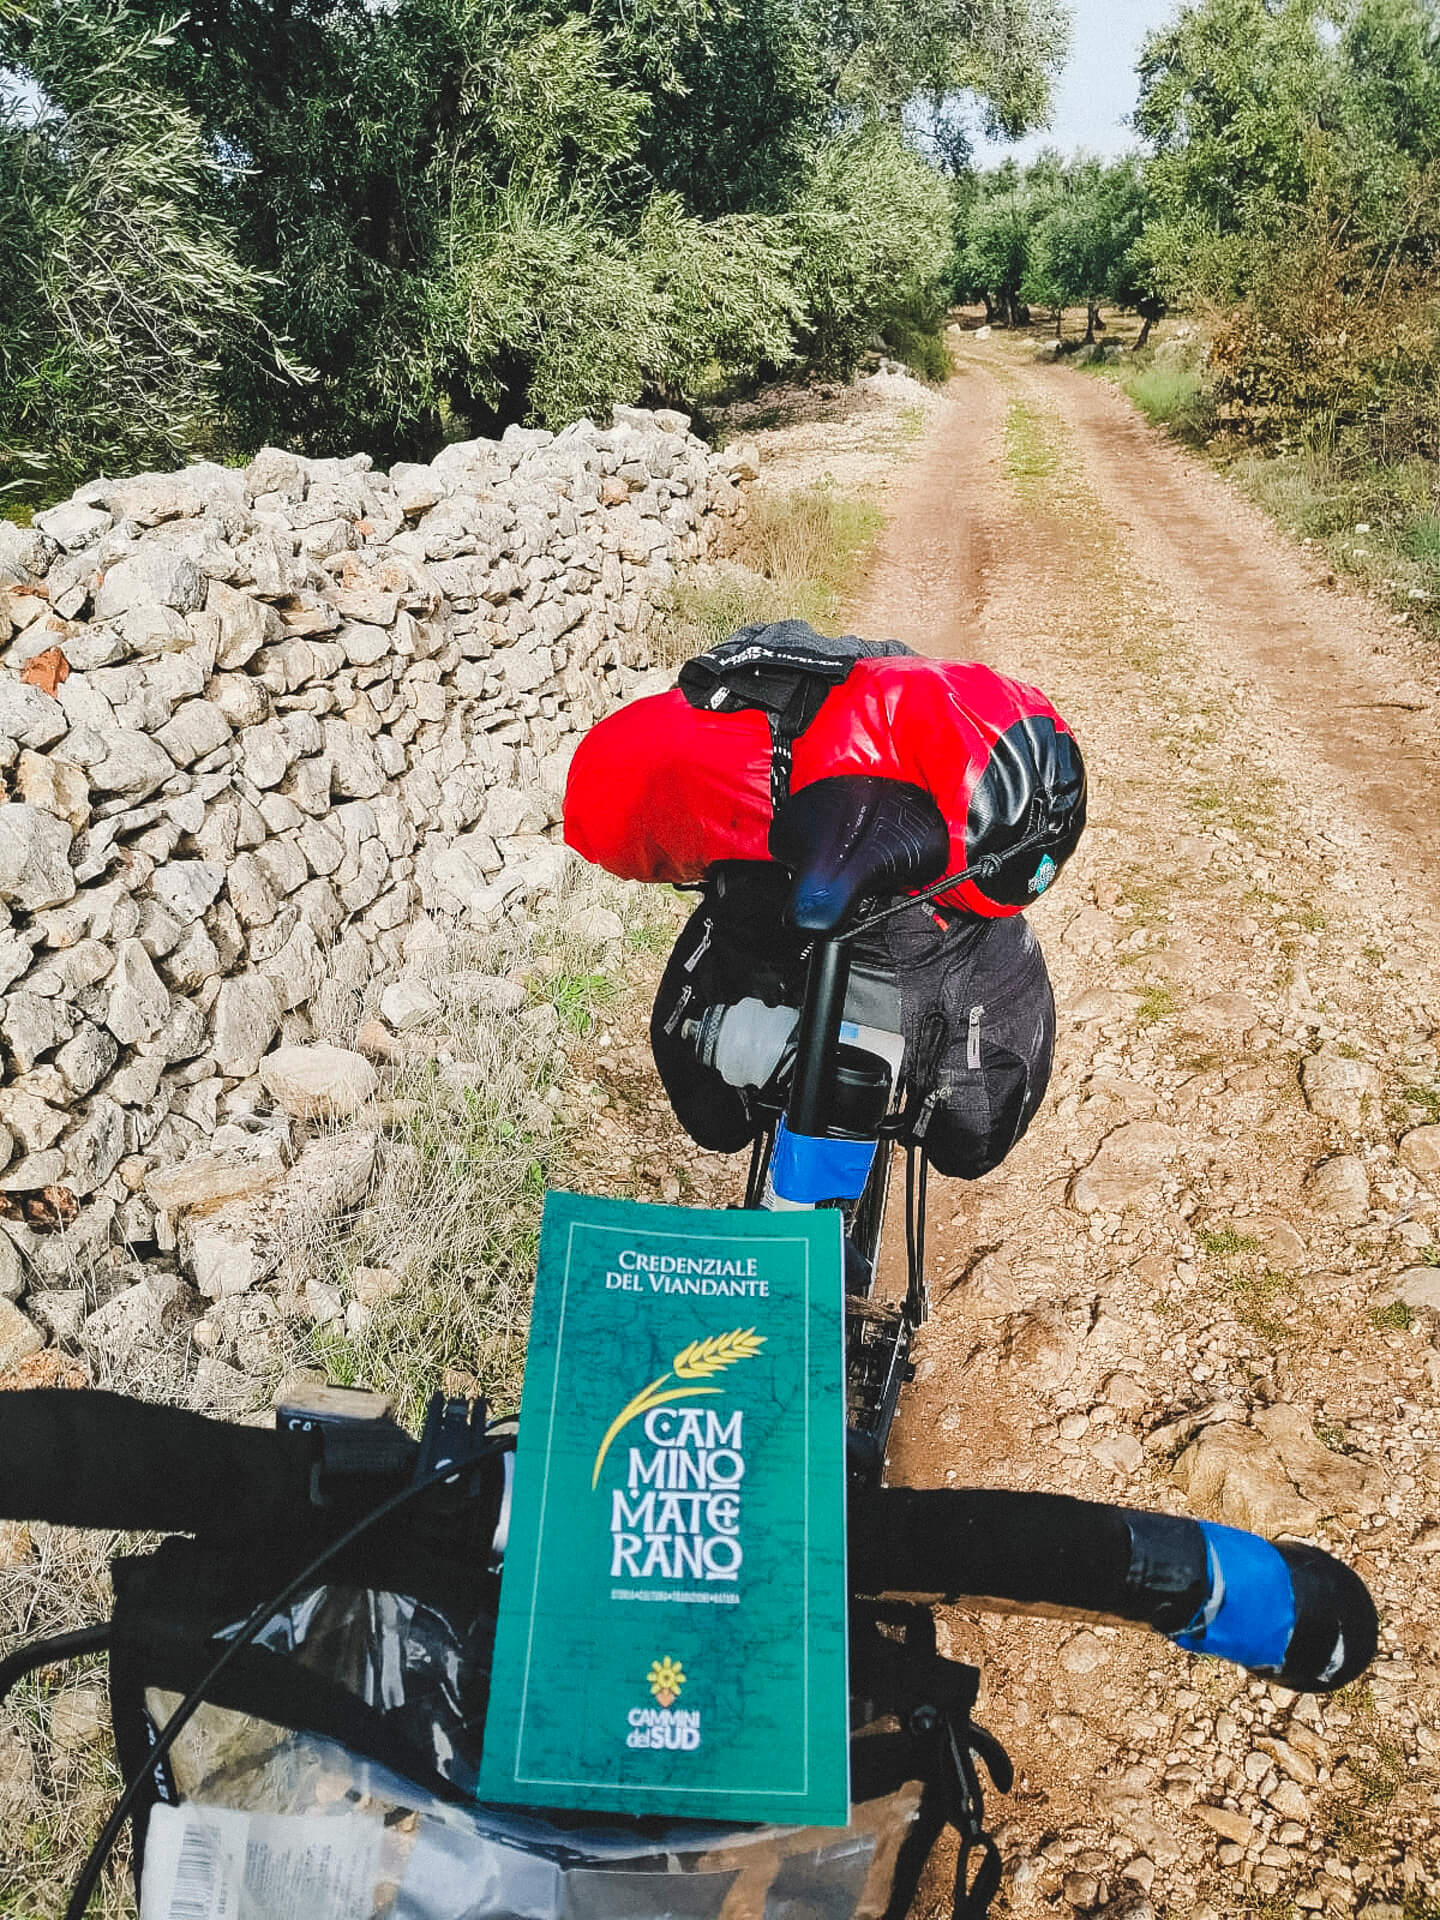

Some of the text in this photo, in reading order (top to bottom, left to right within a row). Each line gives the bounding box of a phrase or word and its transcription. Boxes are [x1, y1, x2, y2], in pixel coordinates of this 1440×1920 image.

[605, 1271, 770, 1297] DEL VIANDANTE
[618, 1250, 758, 1277] CREDENZIALE
[644, 1407, 744, 1450] CAM
[627, 1447, 746, 1491] MINO
[610, 1488, 741, 1536] MATE
[610, 1533, 744, 1581] RANO
